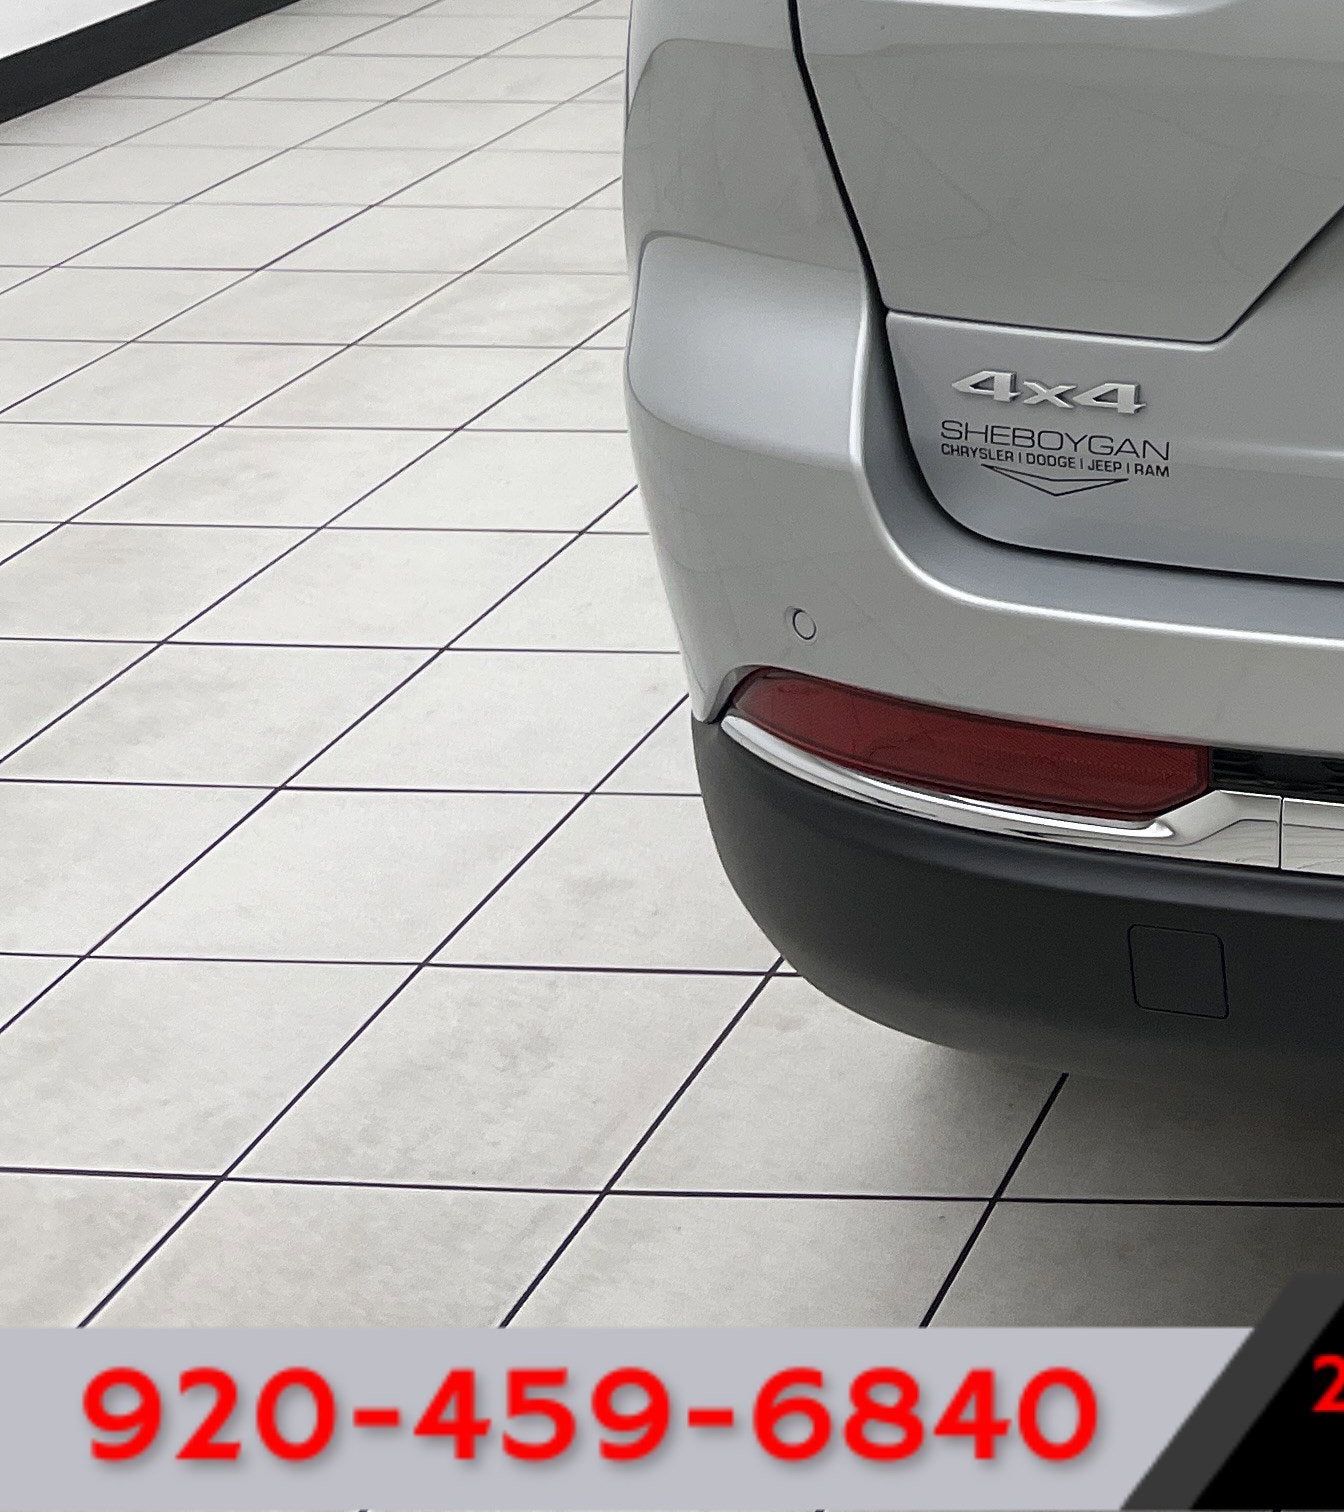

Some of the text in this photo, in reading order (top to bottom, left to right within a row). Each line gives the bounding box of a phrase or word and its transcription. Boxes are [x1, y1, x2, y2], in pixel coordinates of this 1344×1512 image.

[951, 369, 1148, 415] 4x4
[940, 419, 1170, 461] SHEBOYGAN
[941, 442, 1170, 478] CHRYSLER DODGE JEEP RAM
